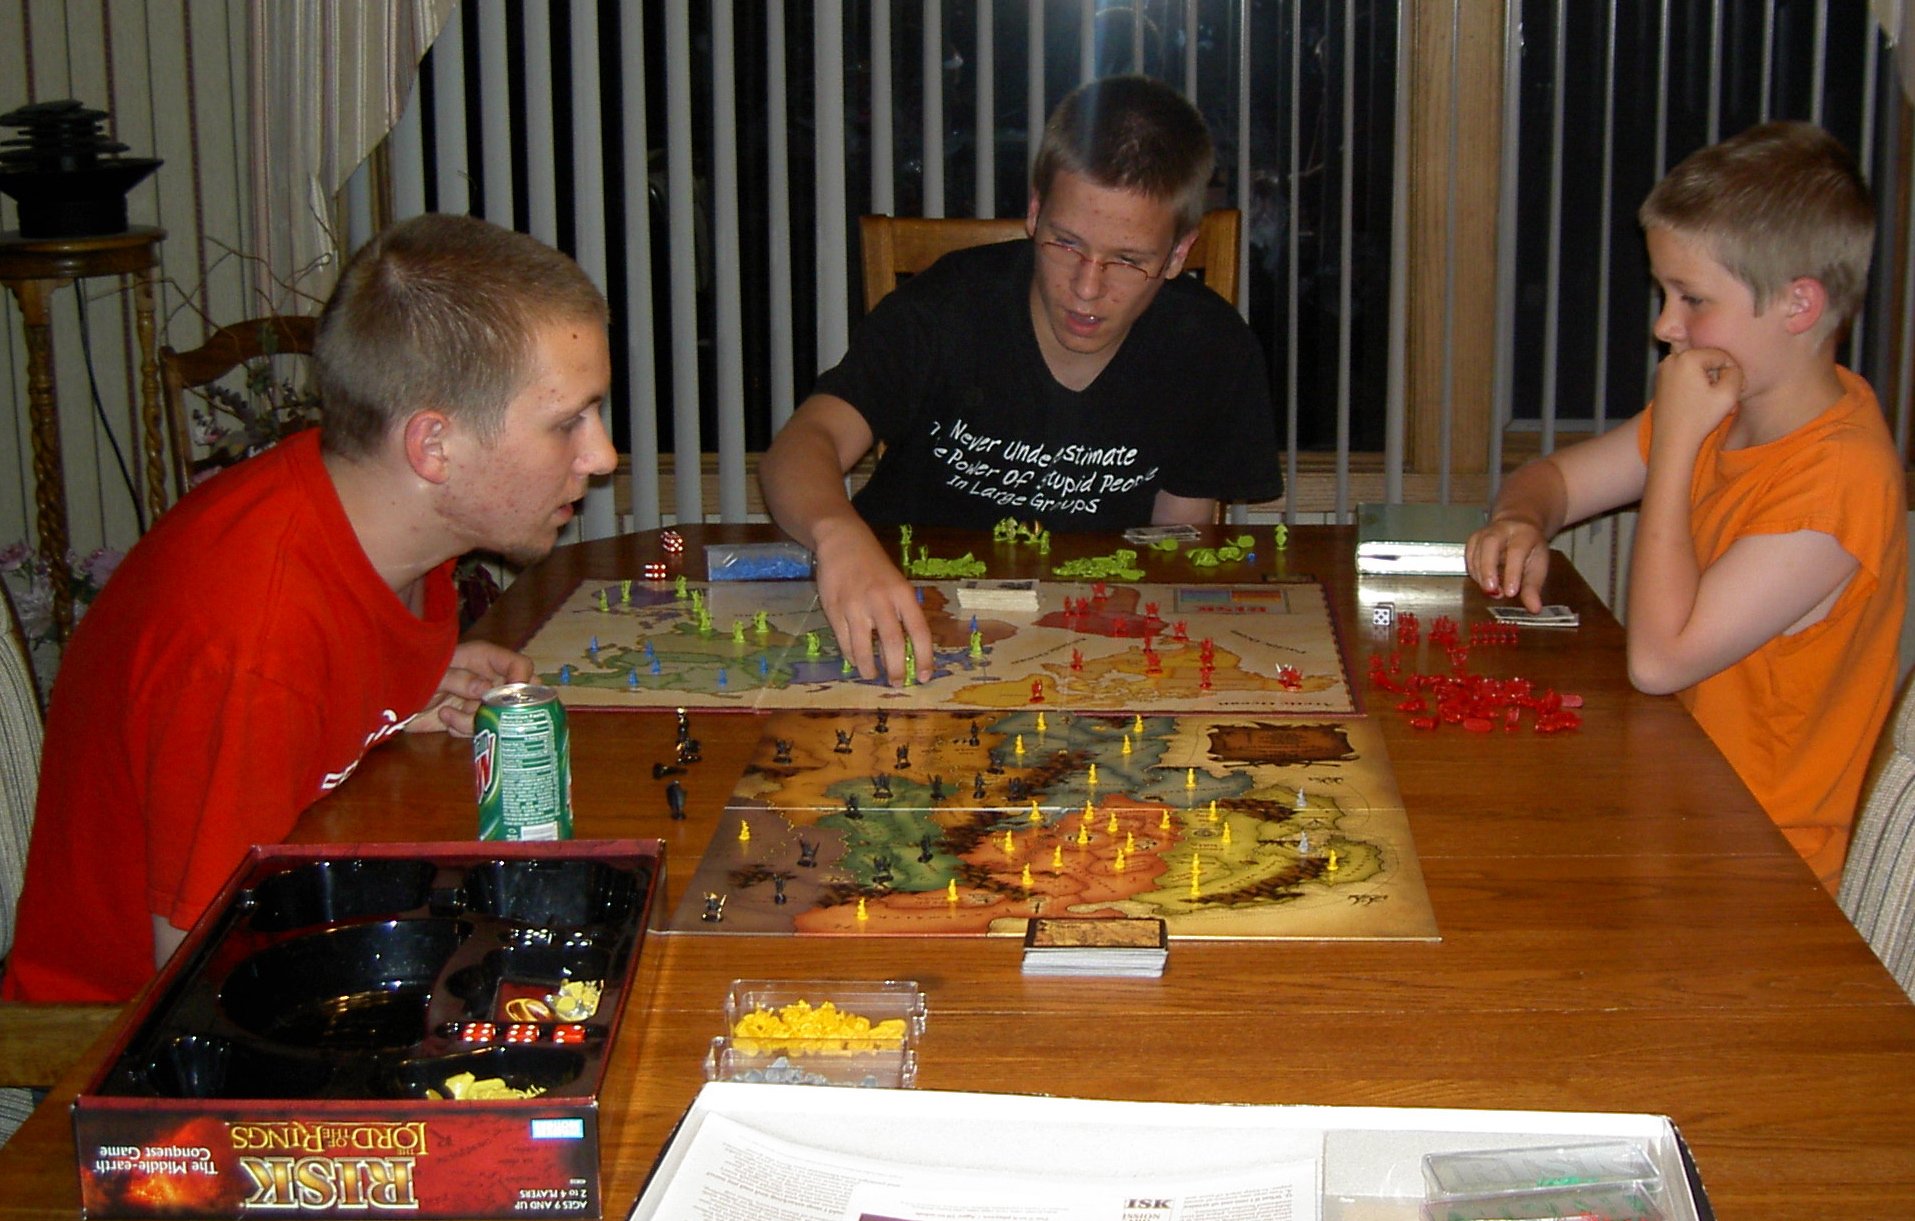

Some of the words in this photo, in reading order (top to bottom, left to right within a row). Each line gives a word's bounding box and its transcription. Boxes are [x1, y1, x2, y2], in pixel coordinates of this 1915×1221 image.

[949, 418, 1003, 455] Never
[1003, 440, 1139, 468] Undestimate
[946, 448, 1001, 479] Power
[1002, 470, 1035, 489] Of
[1035, 470, 1098, 497] tupid
[945, 474, 967, 491] In
[969, 479, 1029, 507] Large
[231, 1121, 323, 1154] RINGS
[327, 1138, 347, 1148] OF
[352, 1121, 428, 1156] LORD
[98, 1144, 142, 1160] Game
[145, 1144, 212, 1161] Conquest
[94, 1159, 188, 1176] Middle-earth
[191, 1160, 218, 1175] The
[239, 1156, 420, 1210] RISK
[519, 1189, 559, 1199] PLAYERS
[559, 1189, 568, 1198] 4
[568, 1189, 579, 1198] to
[581, 1189, 588, 1198] 2
[514, 1200, 529, 1210] UP
[530, 1200, 553, 1210] AND
[554, 1200, 561, 1210] 9
[562, 1199, 588, 1210] AGES
